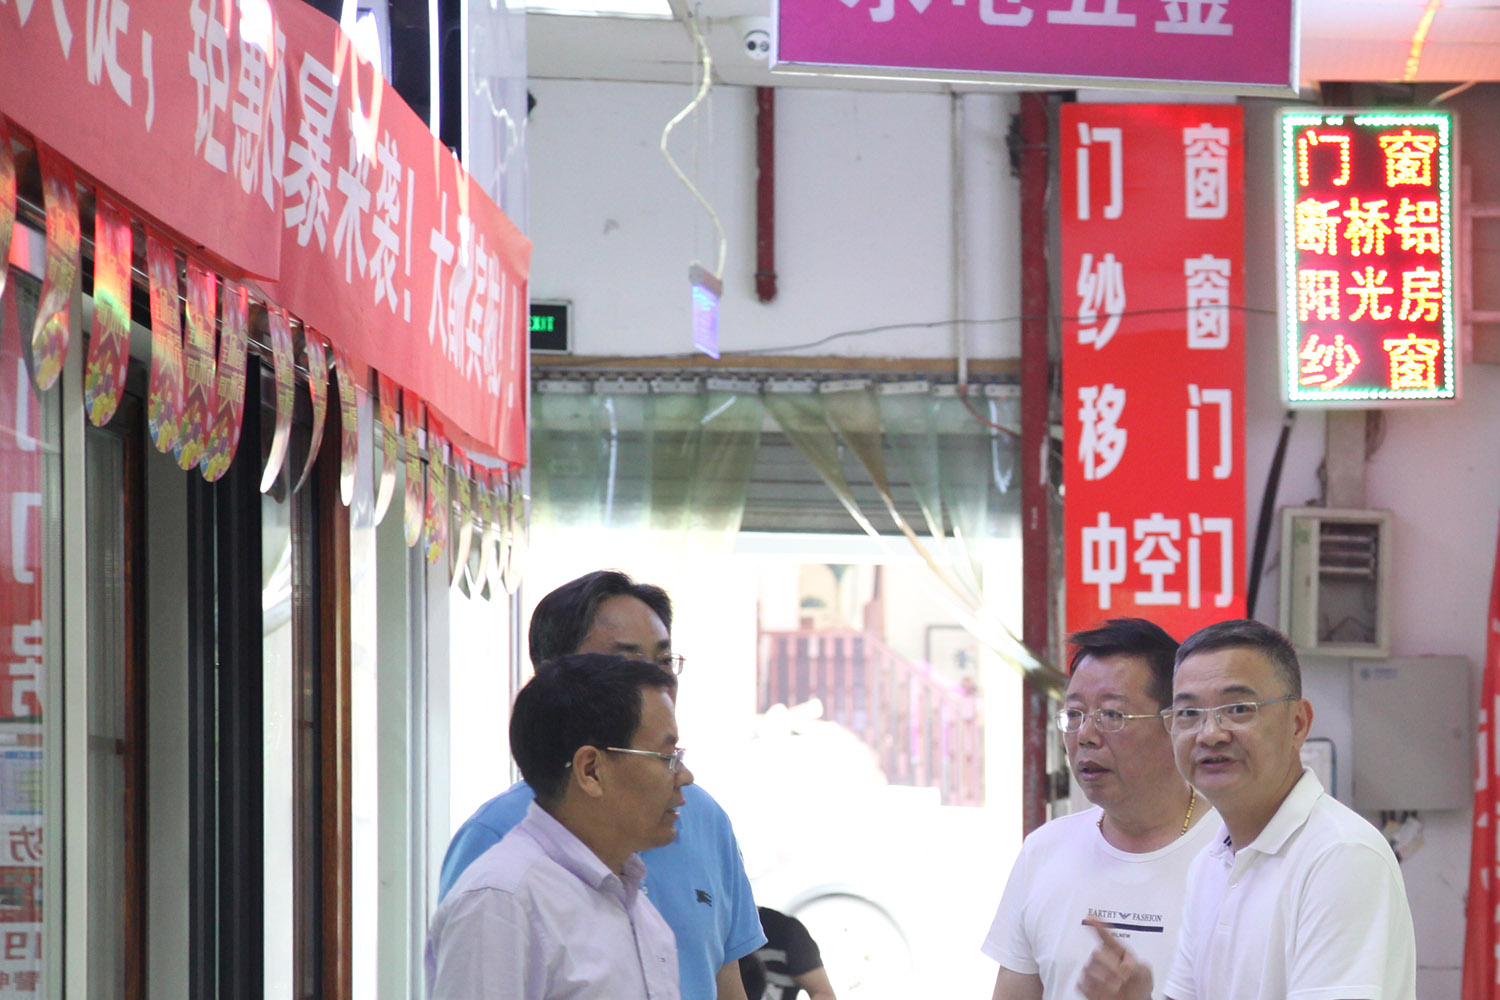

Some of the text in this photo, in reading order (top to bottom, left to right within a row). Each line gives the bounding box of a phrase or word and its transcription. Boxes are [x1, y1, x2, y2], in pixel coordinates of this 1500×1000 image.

[1077, 122, 1229, 220] 门窗
[1298, 130, 1438, 187] 门窗
[1296, 197, 1440, 256] 断桥铝
[1077, 254, 1231, 349] 纱窗
[1298, 265, 1442, 322] 阳光房
[1299, 333, 1440, 391] 纱窗
[1078, 384, 1232, 480] 移门
[1081, 512, 1233, 610] 中空门
[1088, 908, 1162, 922] EARTHY FASHION
